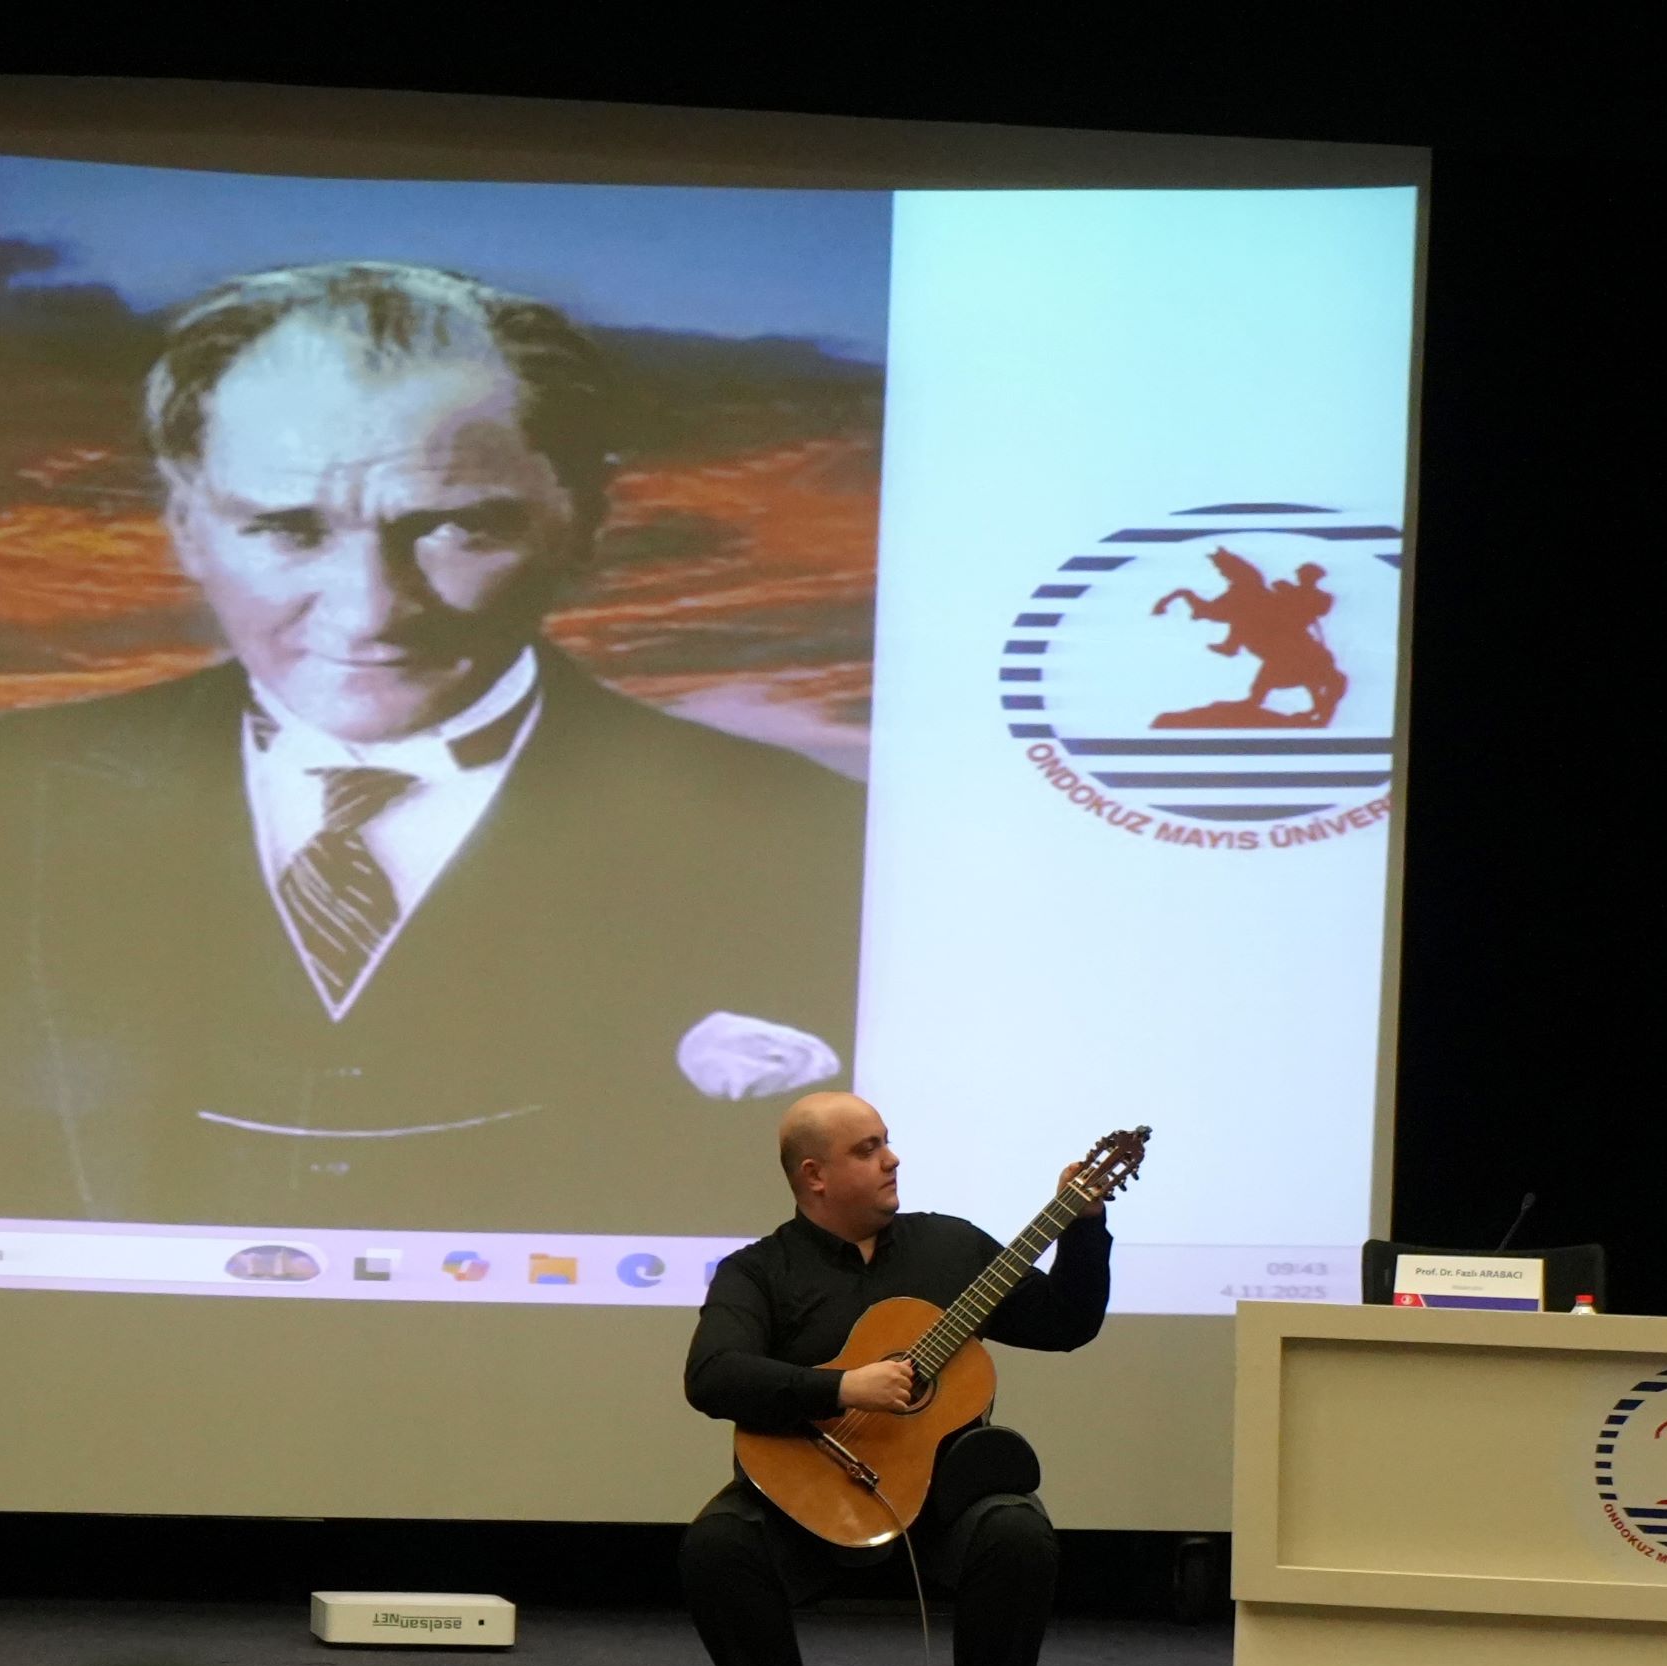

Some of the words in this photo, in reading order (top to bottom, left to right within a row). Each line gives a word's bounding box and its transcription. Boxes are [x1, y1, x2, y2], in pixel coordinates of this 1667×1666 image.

[1026, 743, 1153, 835] ONDOKUZ
[1154, 821, 1260, 850] MAYIS
[1415, 1267, 1437, 1277] Prof.
[1440, 1269, 1453, 1278] Dr.
[1479, 1270, 1523, 1280] ARABACI
[1603, 1503, 1656, 1558] ONDOKUZ
[373, 1613, 400, 1623] NET
[400, 1619, 463, 1632] aselsan
